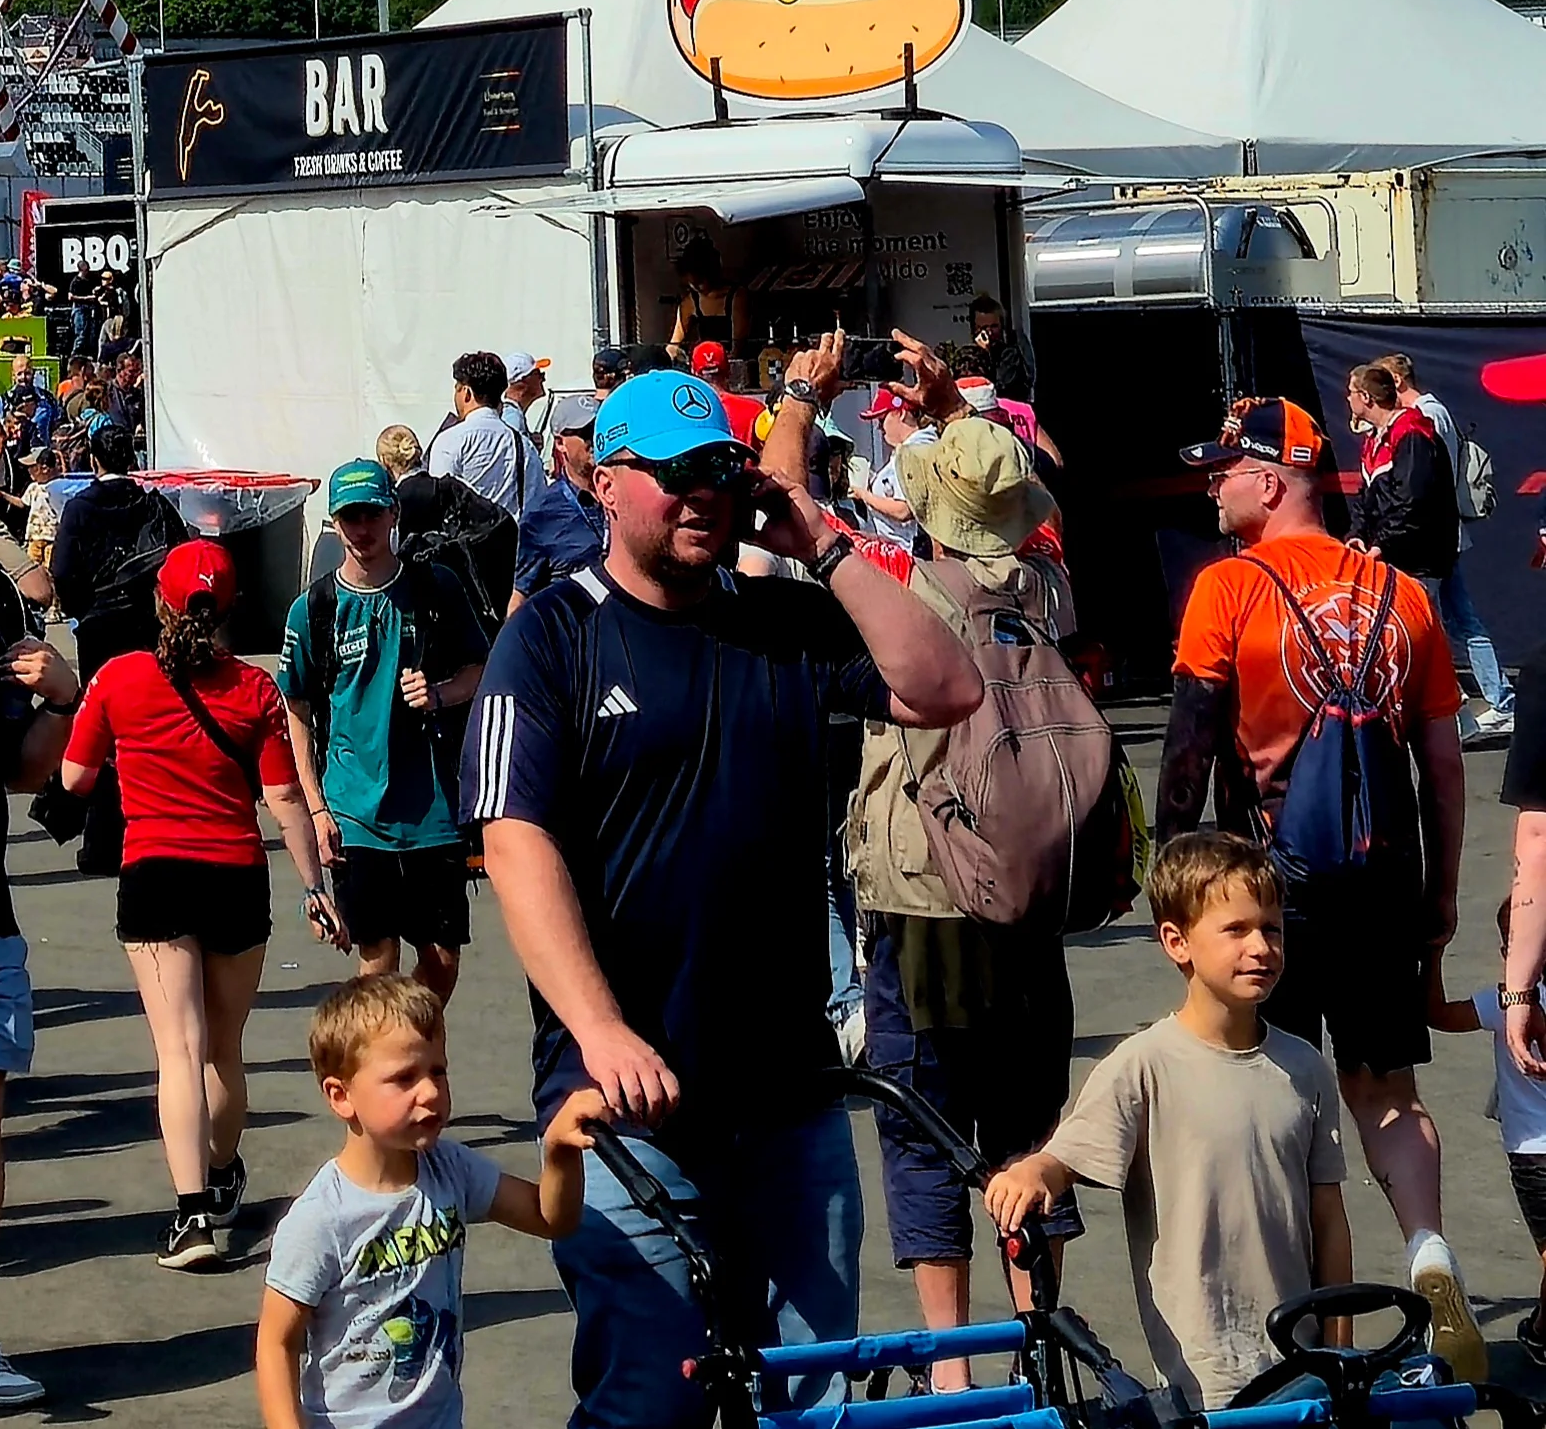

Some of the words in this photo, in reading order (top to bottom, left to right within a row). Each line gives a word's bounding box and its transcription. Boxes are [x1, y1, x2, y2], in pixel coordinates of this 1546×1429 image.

[305, 53, 389, 137] BAR
[293, 155, 323, 177] FRESH
[323, 152, 357, 175] DRINKS
[358, 151, 367, 173] &
[367, 149, 403, 172] COFFEE
[62, 234, 130, 274] BBQ
